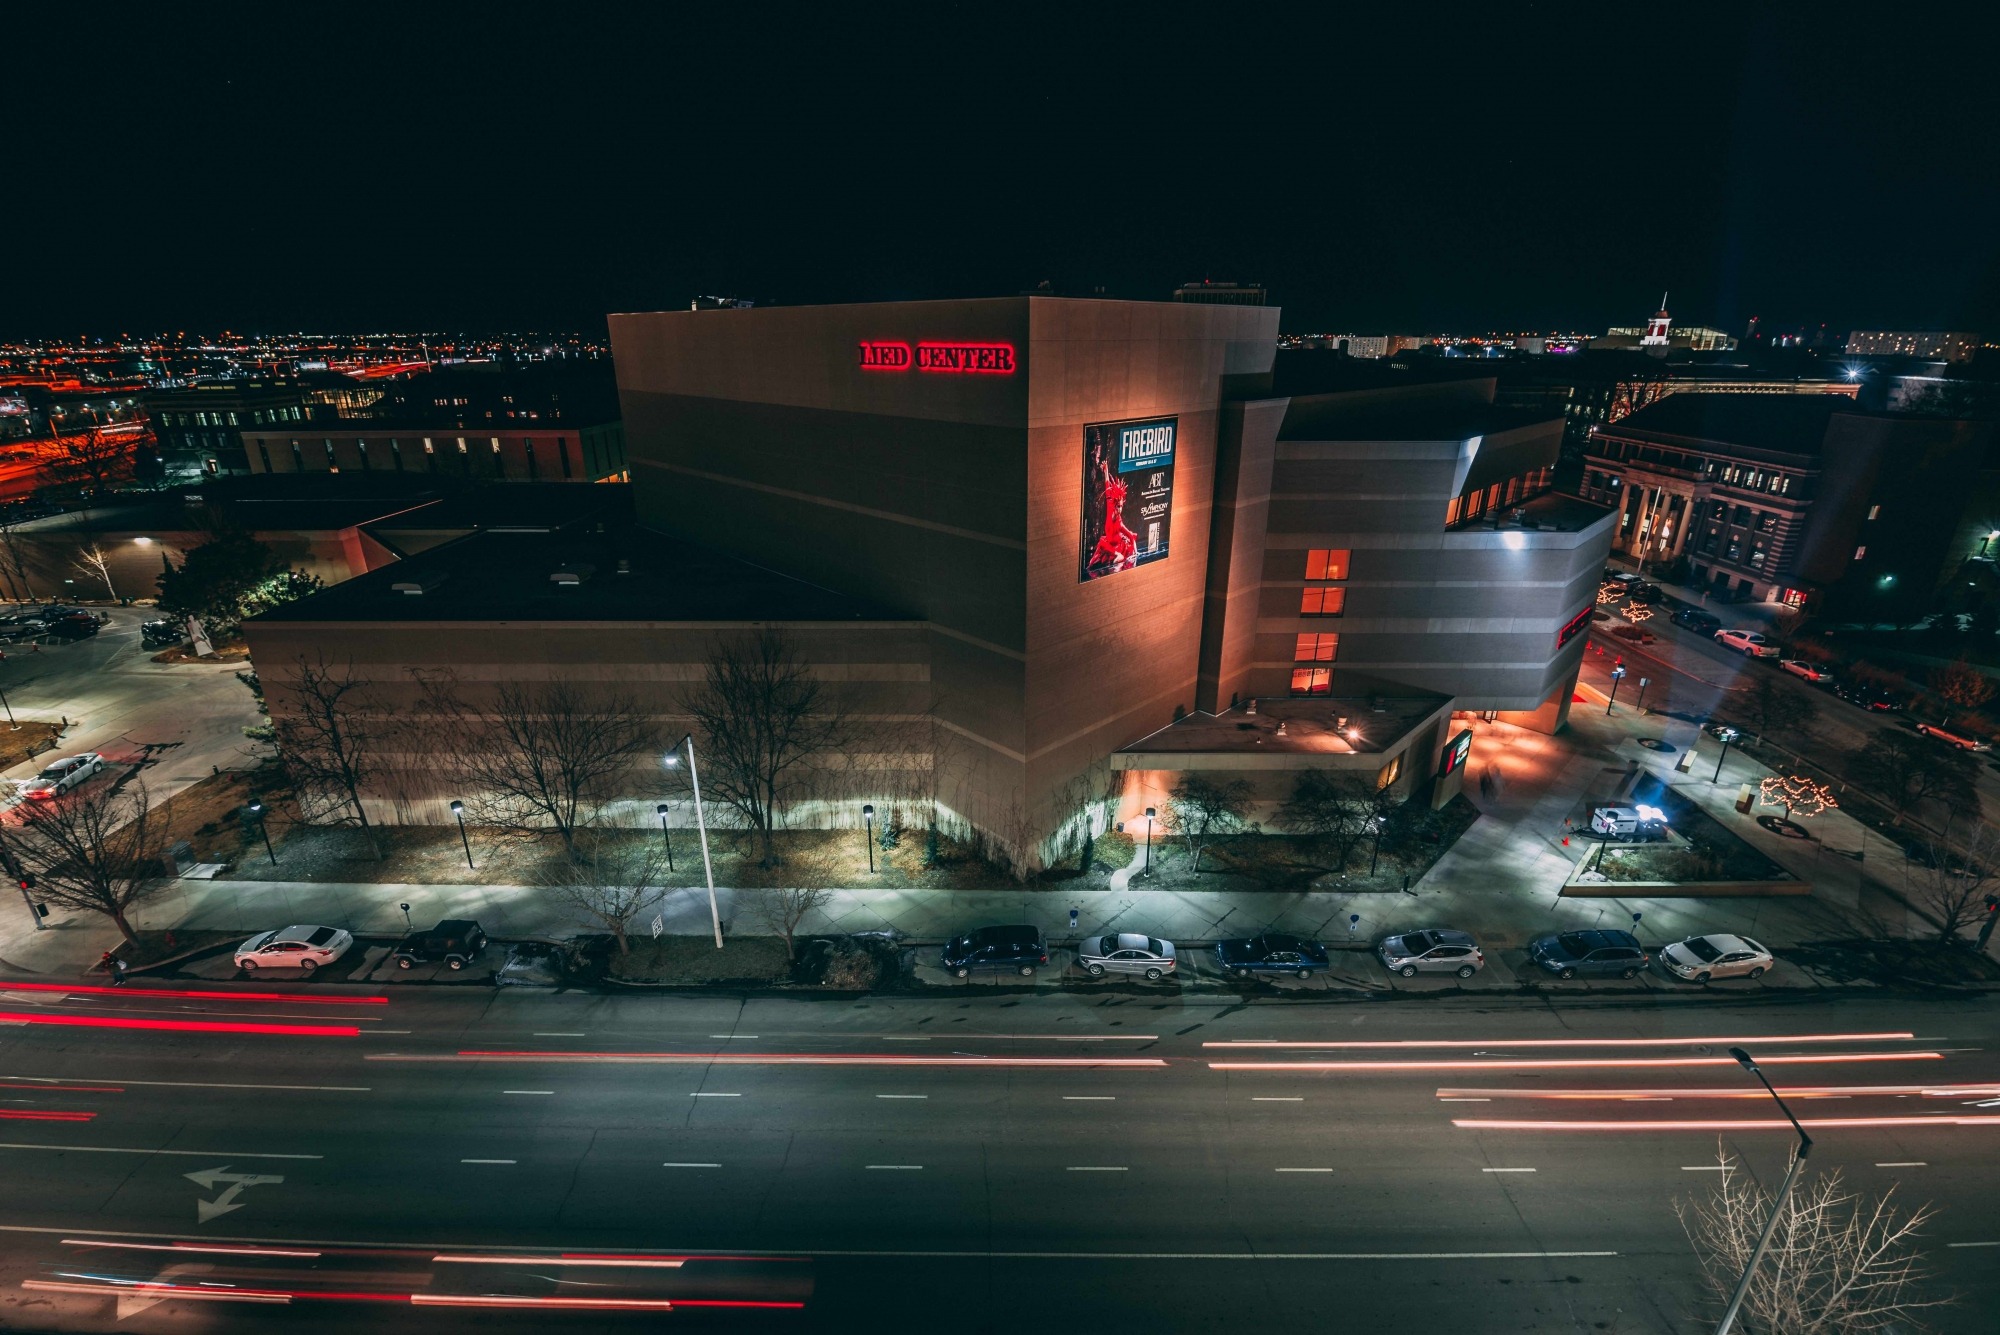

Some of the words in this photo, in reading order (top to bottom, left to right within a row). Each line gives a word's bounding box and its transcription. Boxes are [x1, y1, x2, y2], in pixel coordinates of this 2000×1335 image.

[859, 345, 909, 366] LIED
[914, 346, 1014, 371] CENTER
[1122, 427, 1172, 459] FIREBIRD
